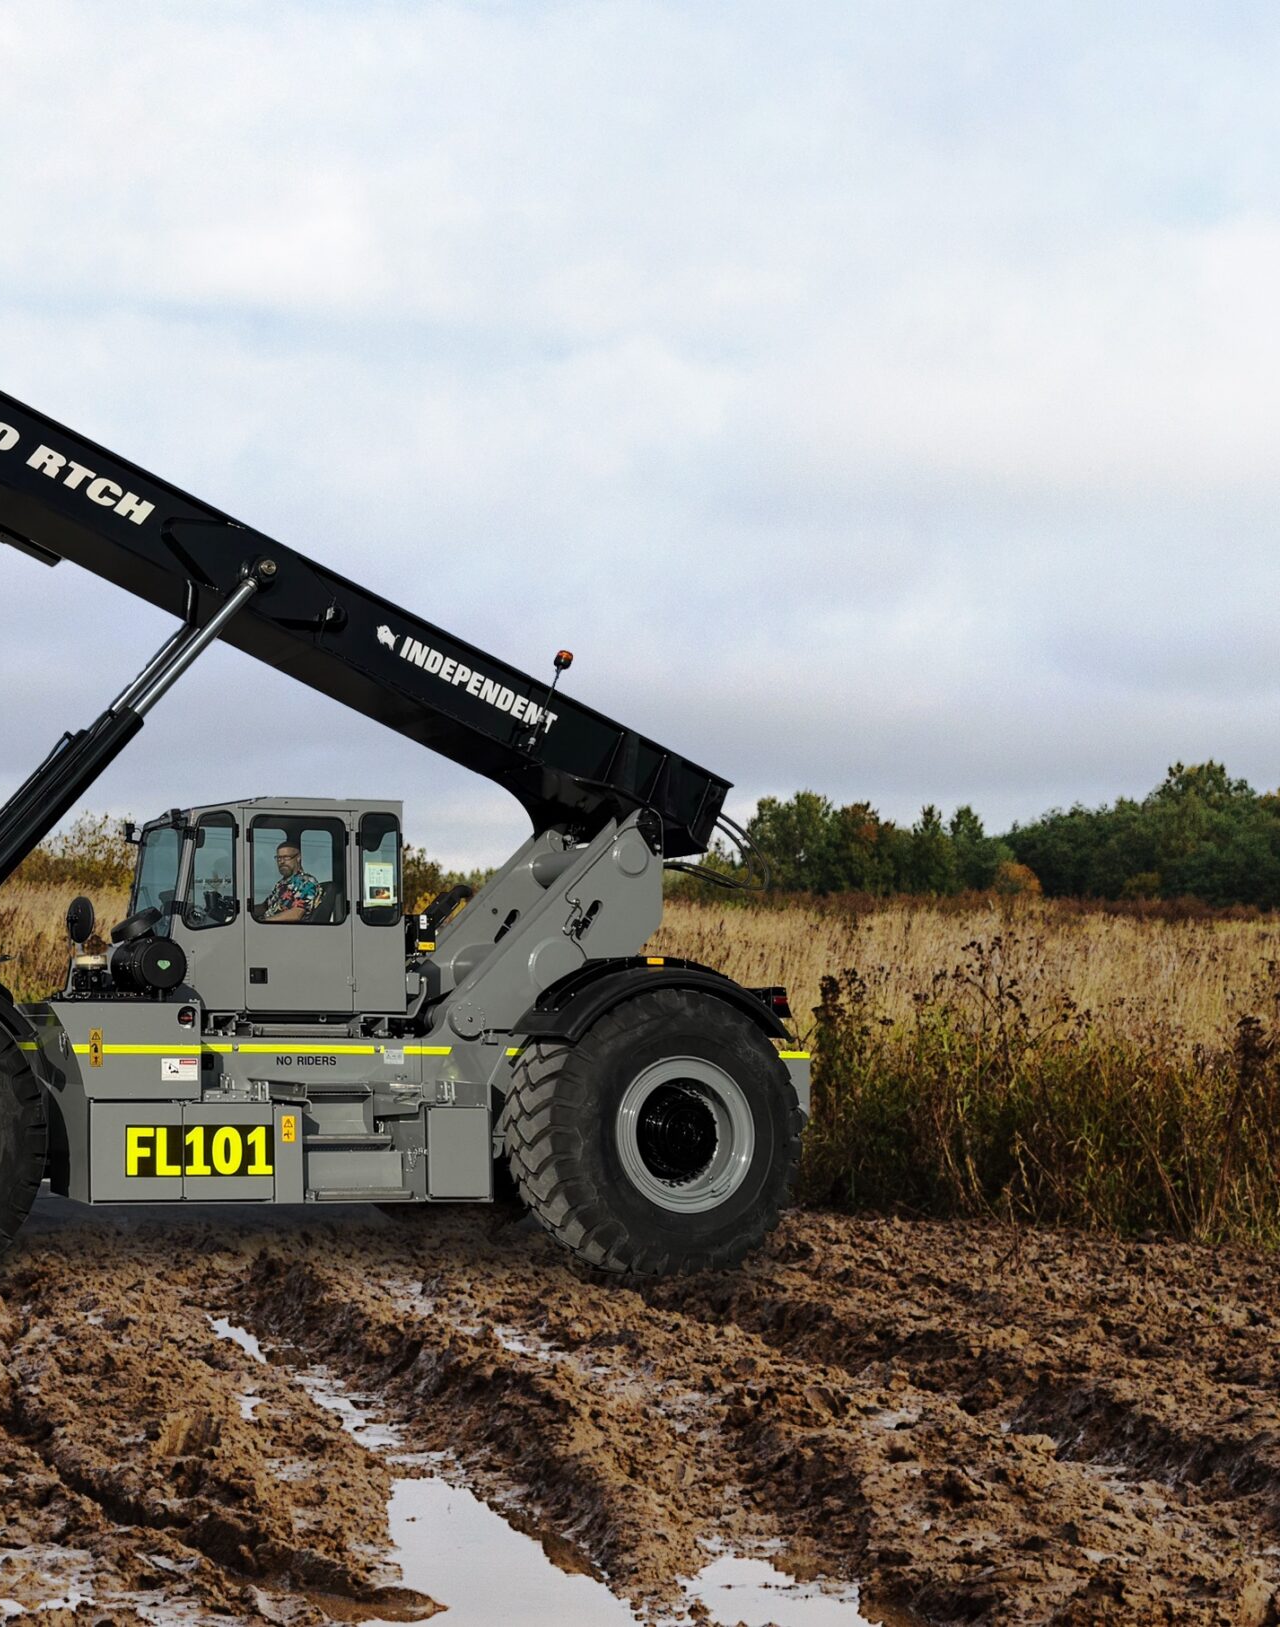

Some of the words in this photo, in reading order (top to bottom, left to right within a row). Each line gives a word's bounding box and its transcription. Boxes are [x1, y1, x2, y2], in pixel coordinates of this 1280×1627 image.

[25, 444, 156, 526] RTCH
[399, 636, 558, 734] INDEPENDENT
[276, 1055, 293, 1066] NO
[296, 1055, 337, 1066] RIDERS
[126, 1126, 273, 1176] FL101
